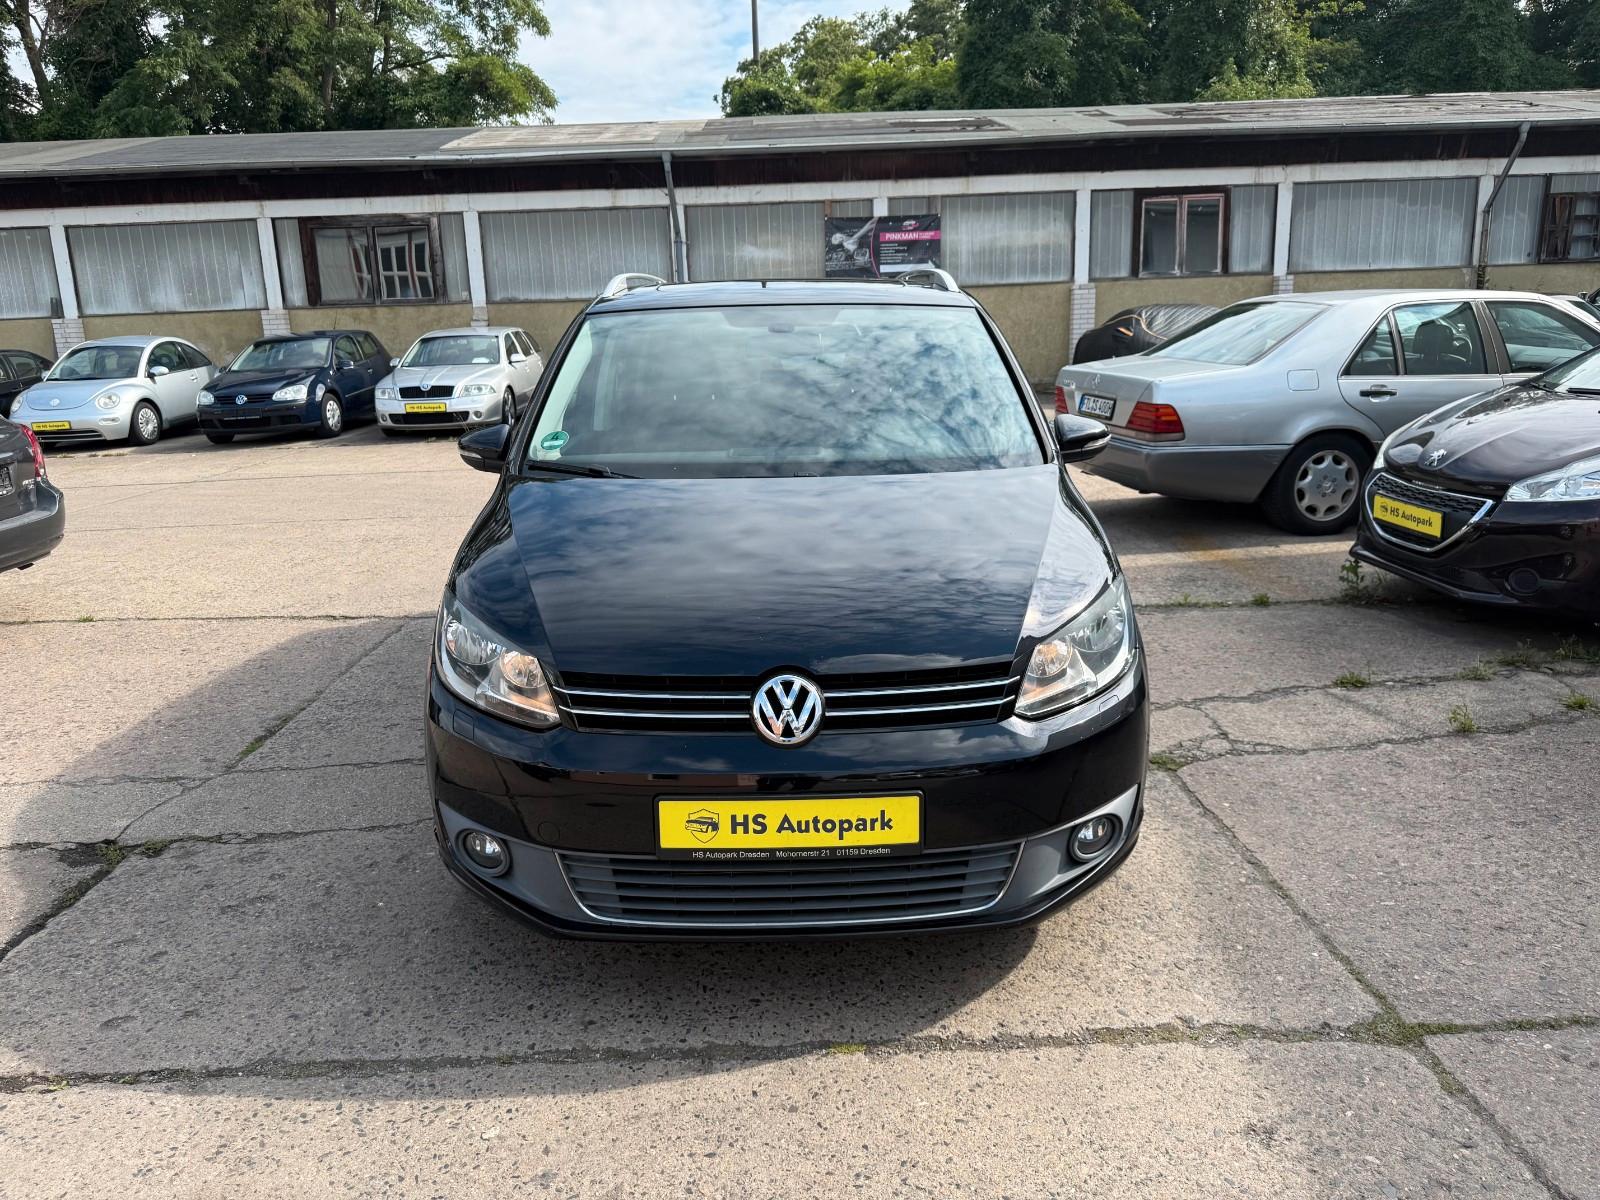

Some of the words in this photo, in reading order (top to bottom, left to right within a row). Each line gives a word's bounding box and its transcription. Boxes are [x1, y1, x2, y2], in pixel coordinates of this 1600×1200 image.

[885, 232, 919, 240] PINKMAN
[551, 432, 560, 440] 4
[1390, 506, 1400, 517] HS
[1401, 510, 1433, 527] Autopark
[730, 814, 768, 834] HS
[776, 810, 893, 840] Autopark
[706, 851, 738, 859] Autopark
[836, 848, 859, 856] 01159
[860, 847, 891, 855] Dresden
